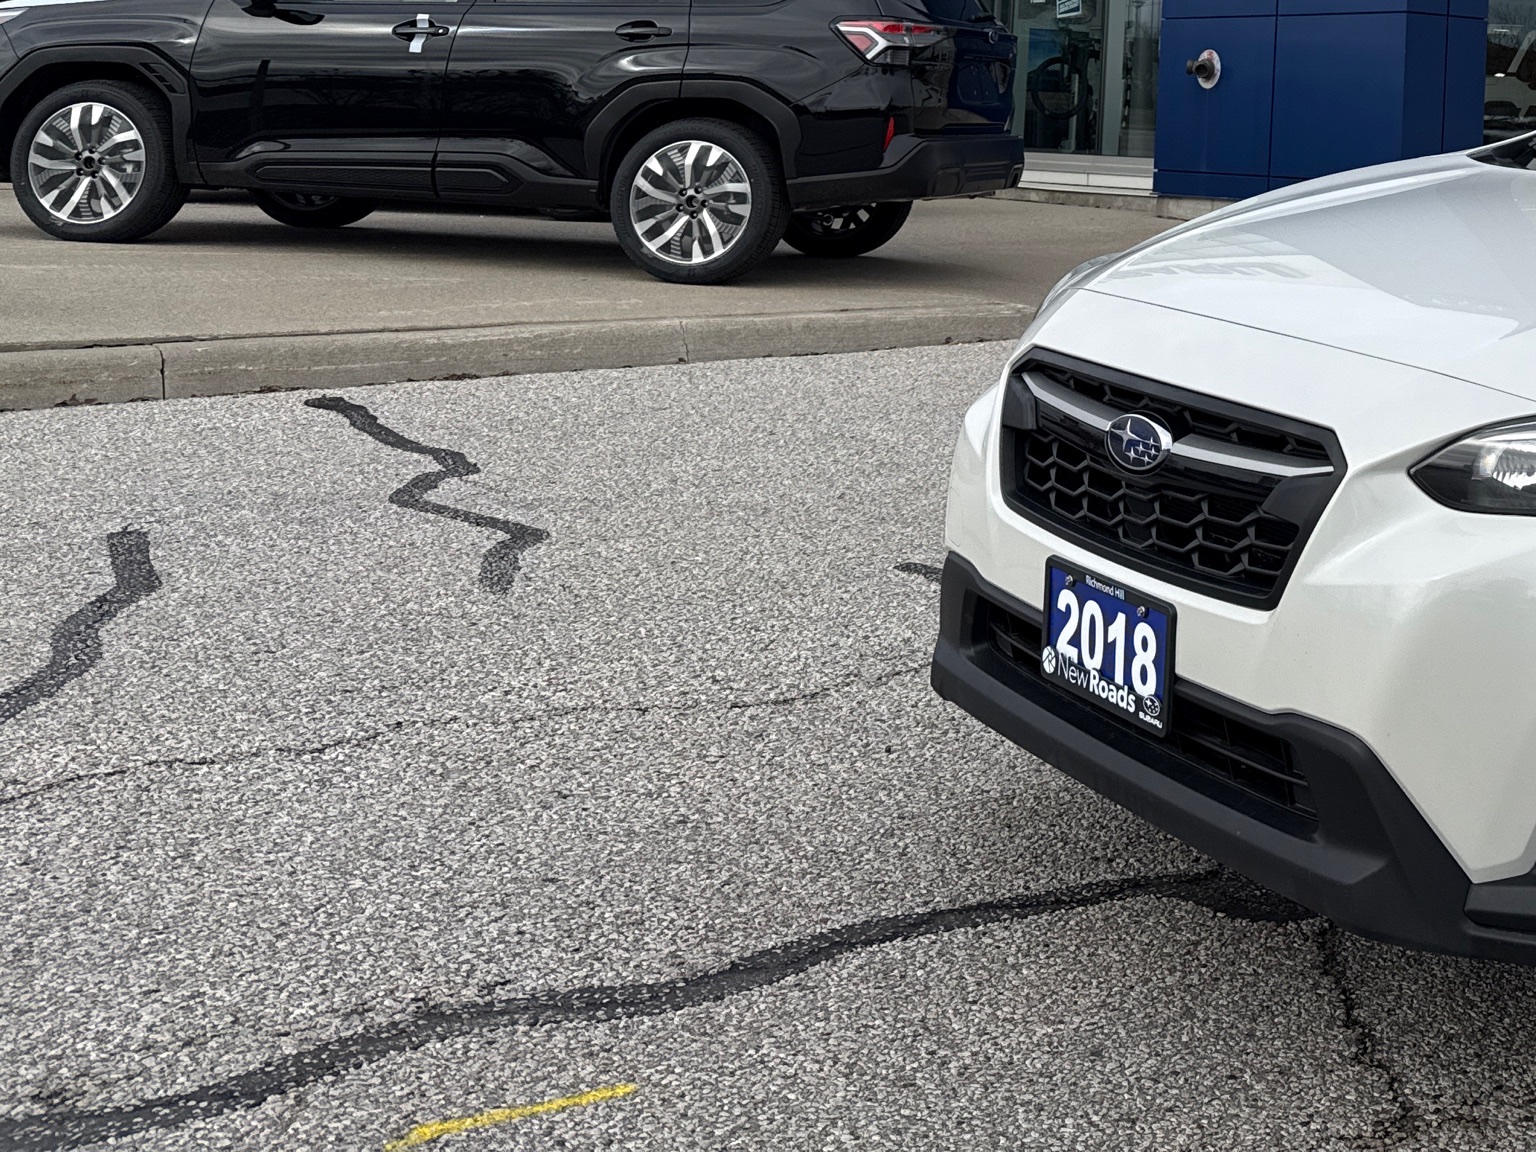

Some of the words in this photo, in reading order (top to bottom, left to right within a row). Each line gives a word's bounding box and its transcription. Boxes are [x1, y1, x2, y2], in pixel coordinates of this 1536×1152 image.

[1085, 574, 1114, 597] Richmond
[1114, 584, 1125, 600] Hill
[1056, 588, 1157, 697] 2018
[1057, 653, 1136, 713] NewRoads
[1138, 711, 1163, 729] SUBARU
